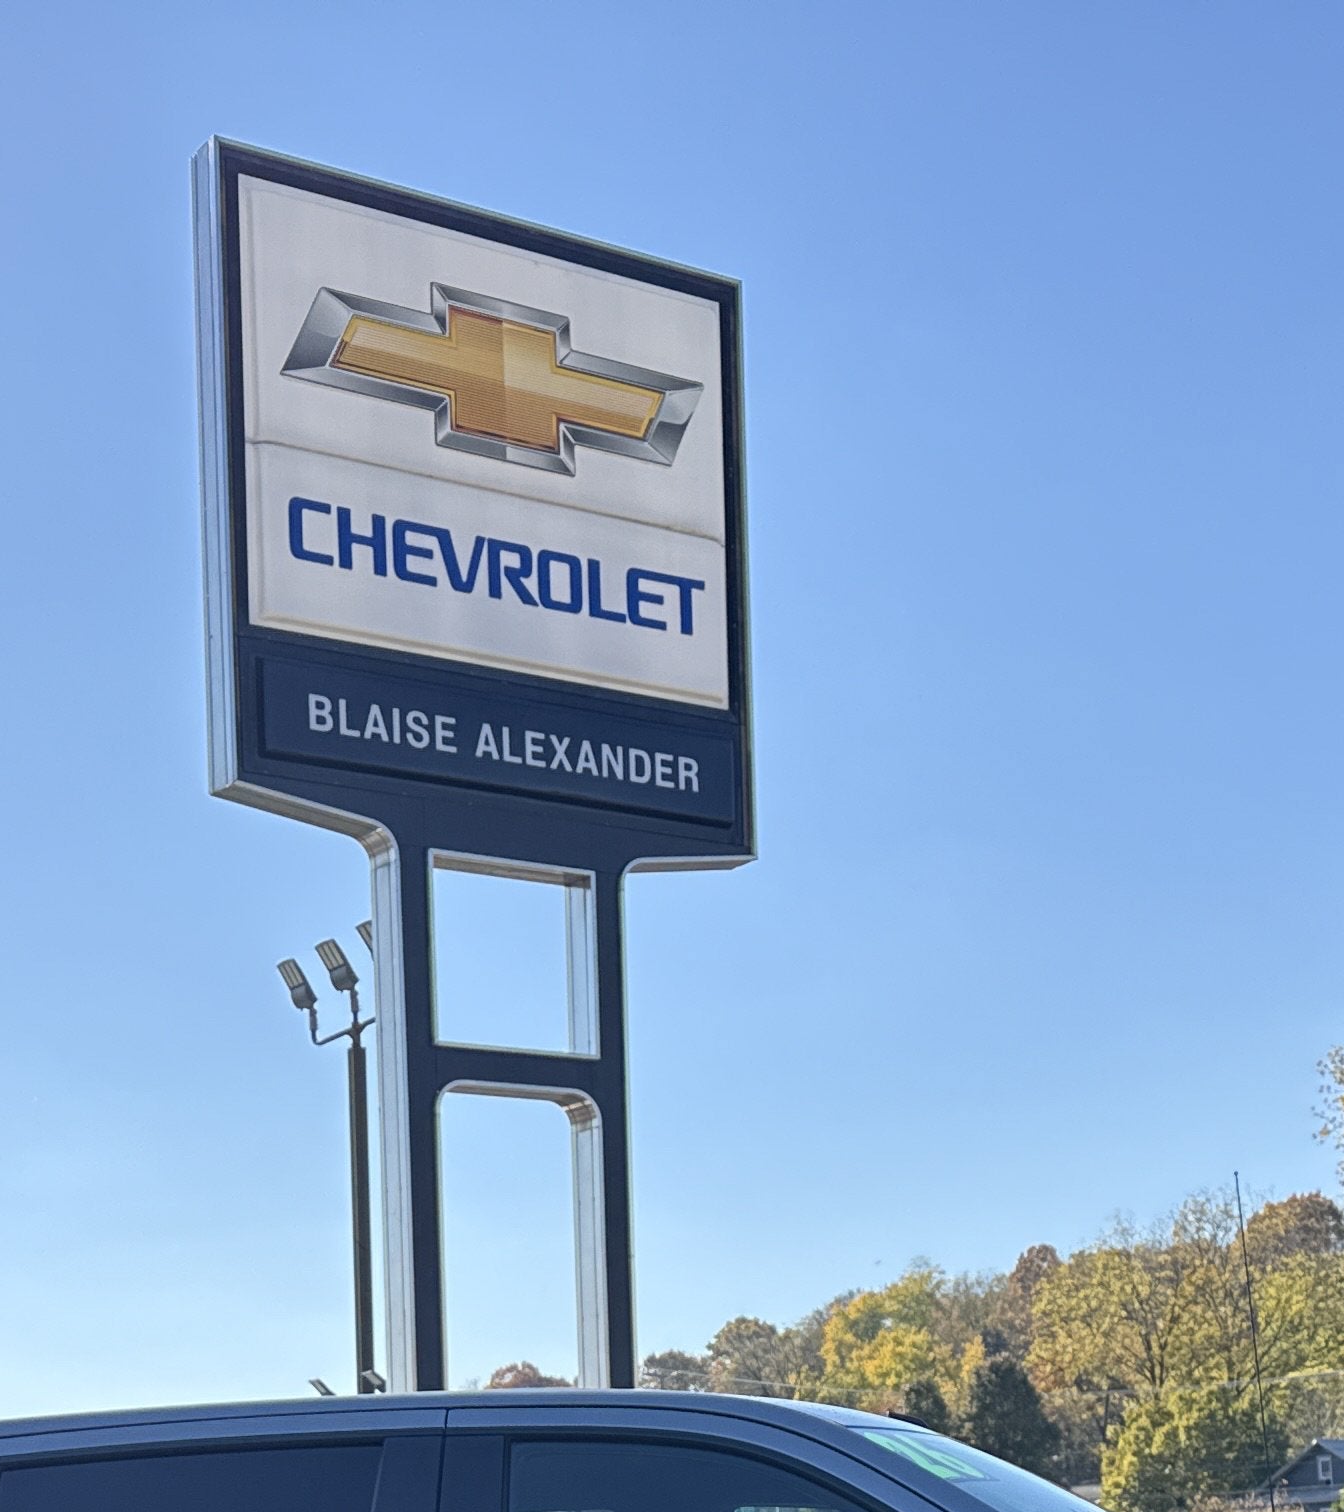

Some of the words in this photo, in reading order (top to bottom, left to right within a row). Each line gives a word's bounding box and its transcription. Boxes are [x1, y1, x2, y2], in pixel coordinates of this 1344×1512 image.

[288, 496, 705, 635] CHEVROLET
[308, 693, 457, 753] BLAISE
[475, 723, 699, 792] ALEXANDER
